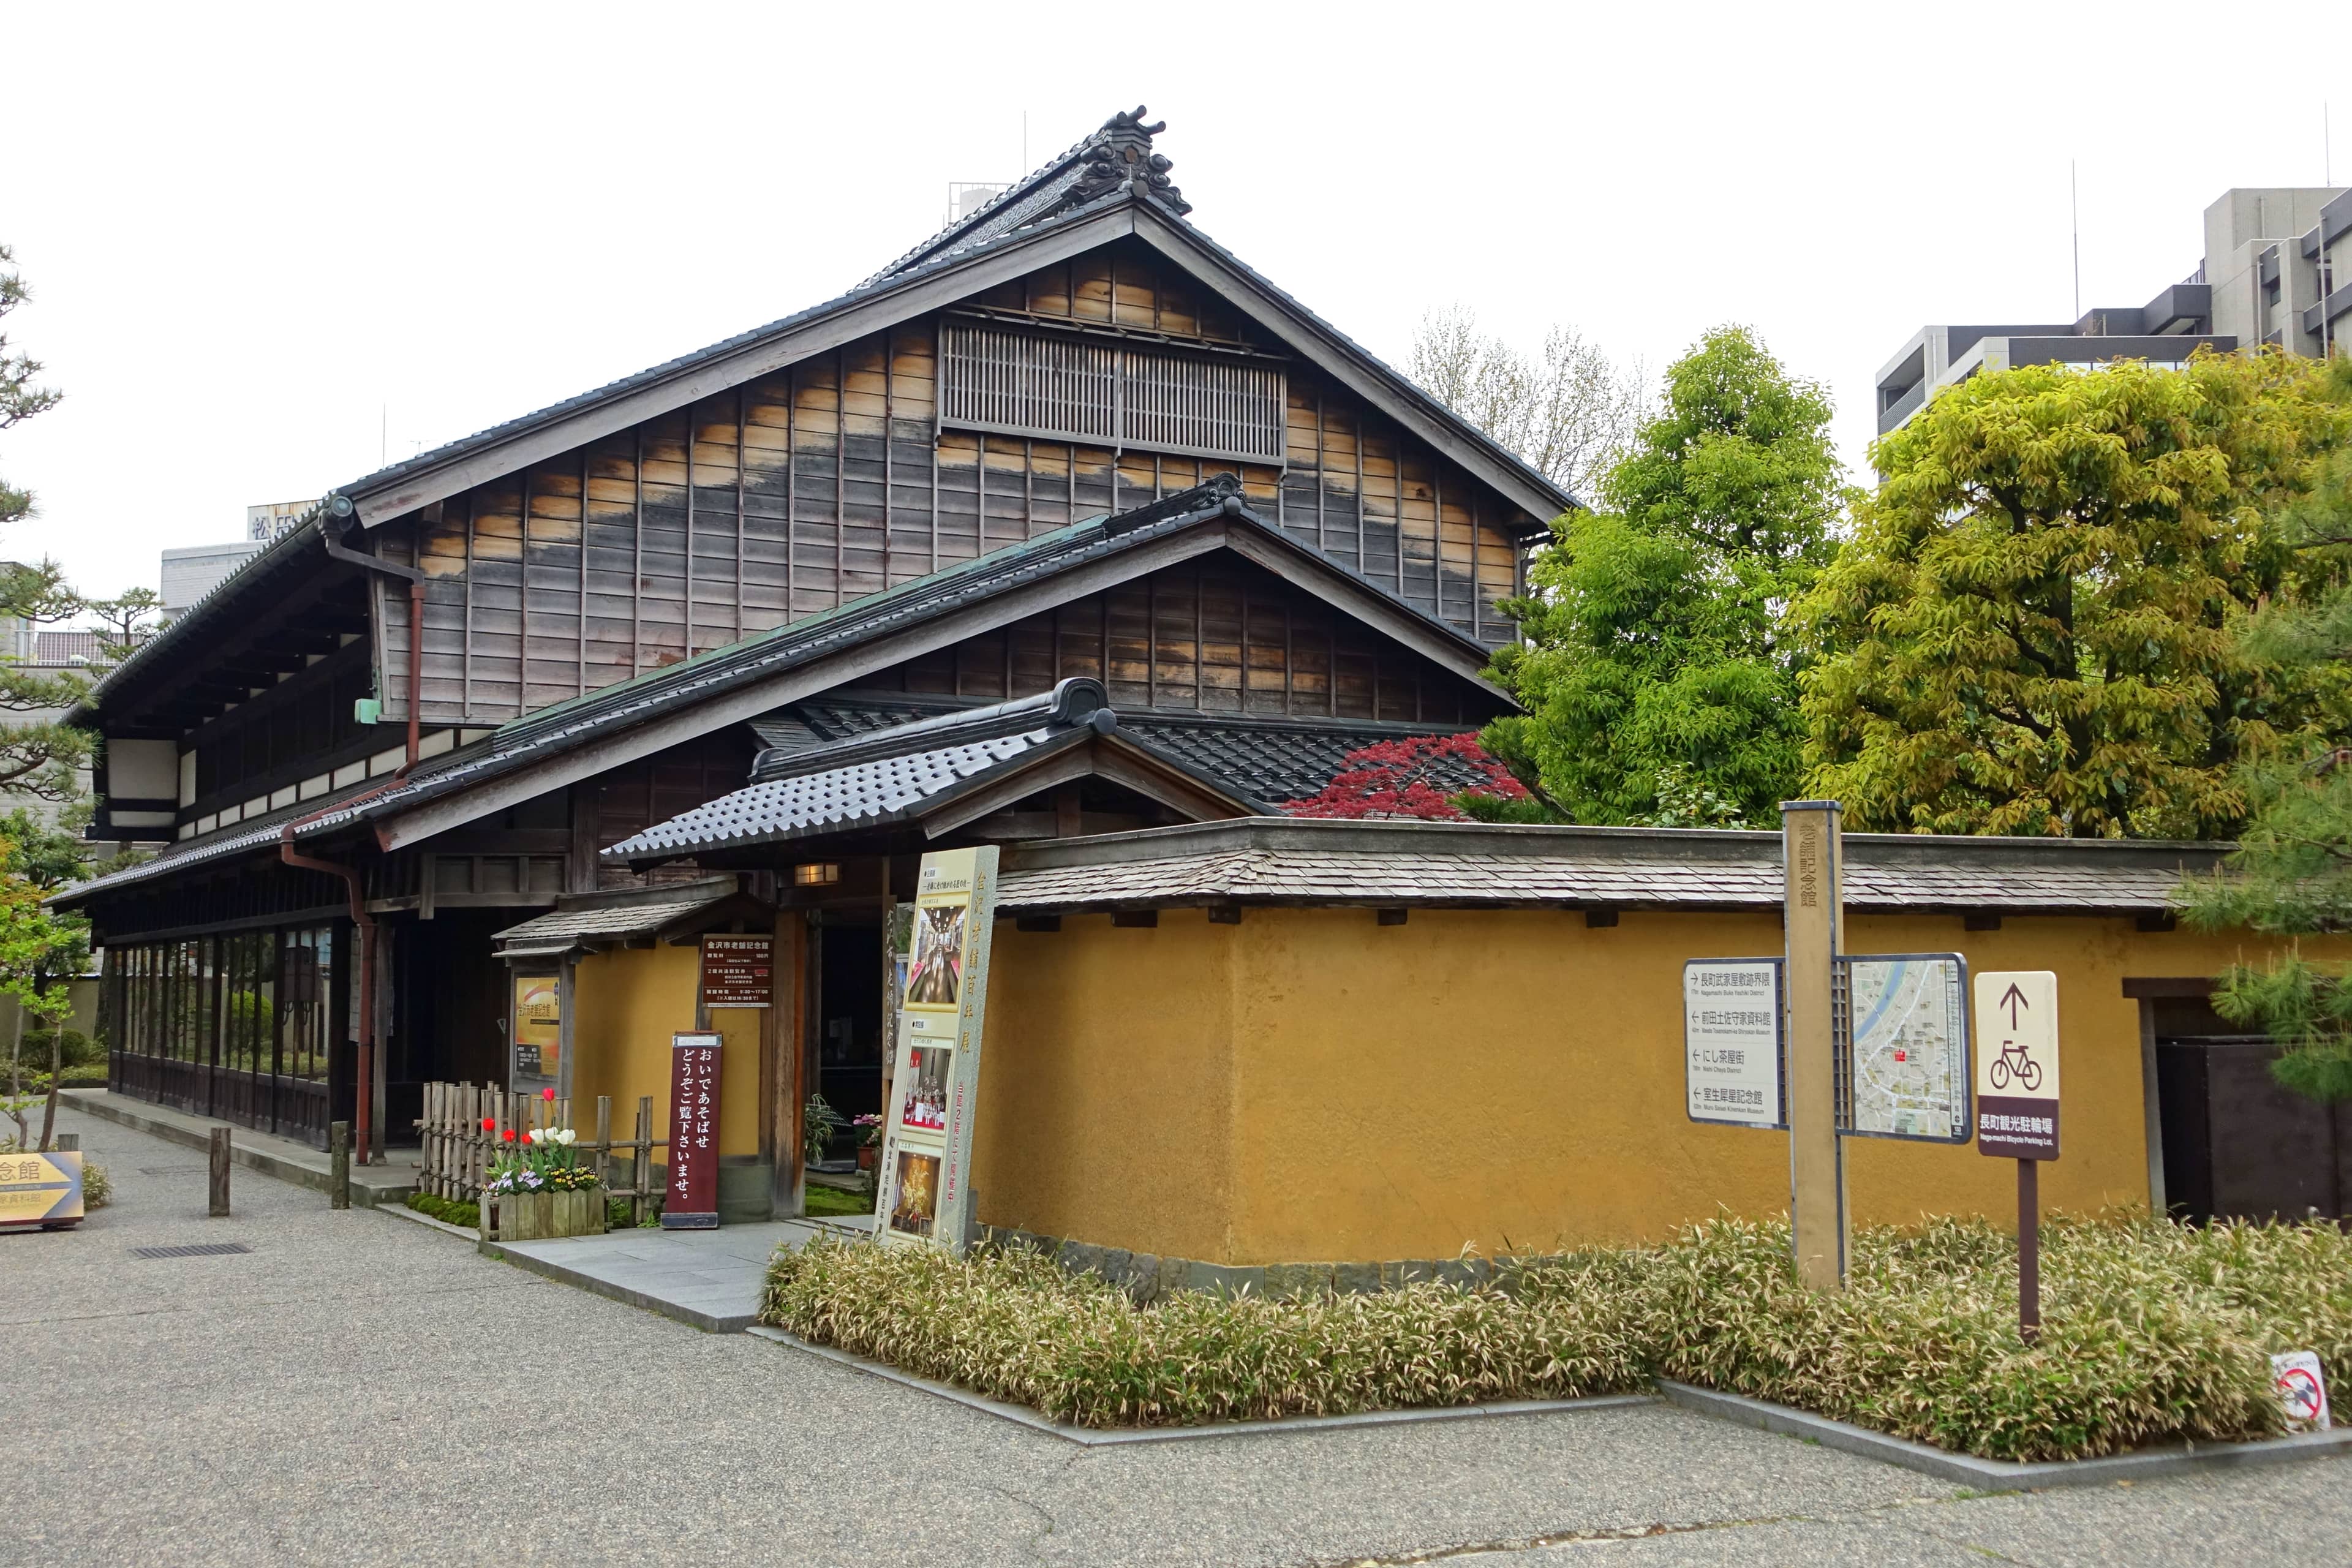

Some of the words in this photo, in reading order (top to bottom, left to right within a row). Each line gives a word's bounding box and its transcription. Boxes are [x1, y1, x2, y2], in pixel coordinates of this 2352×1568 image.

[1701, 972, 1770, 987] 長町武家屋敷跡界隈
[1702, 1011, 1771, 1025] 前田土佐守家資料館
[1703, 1049, 1744, 1065] にし茶屋街
[696, 1049, 712, 1148] おいであそばせ
[1703, 1088, 1763, 1105] 室生犀星記念館
[675, 1049, 695, 1200] どうぞご覧下さいませ。
[1980, 1114, 2053, 1134] 長町観光駐輪場
[2007, 1135, 2024, 1144] Bicycle
[2024, 1137, 2043, 1147] Parking
